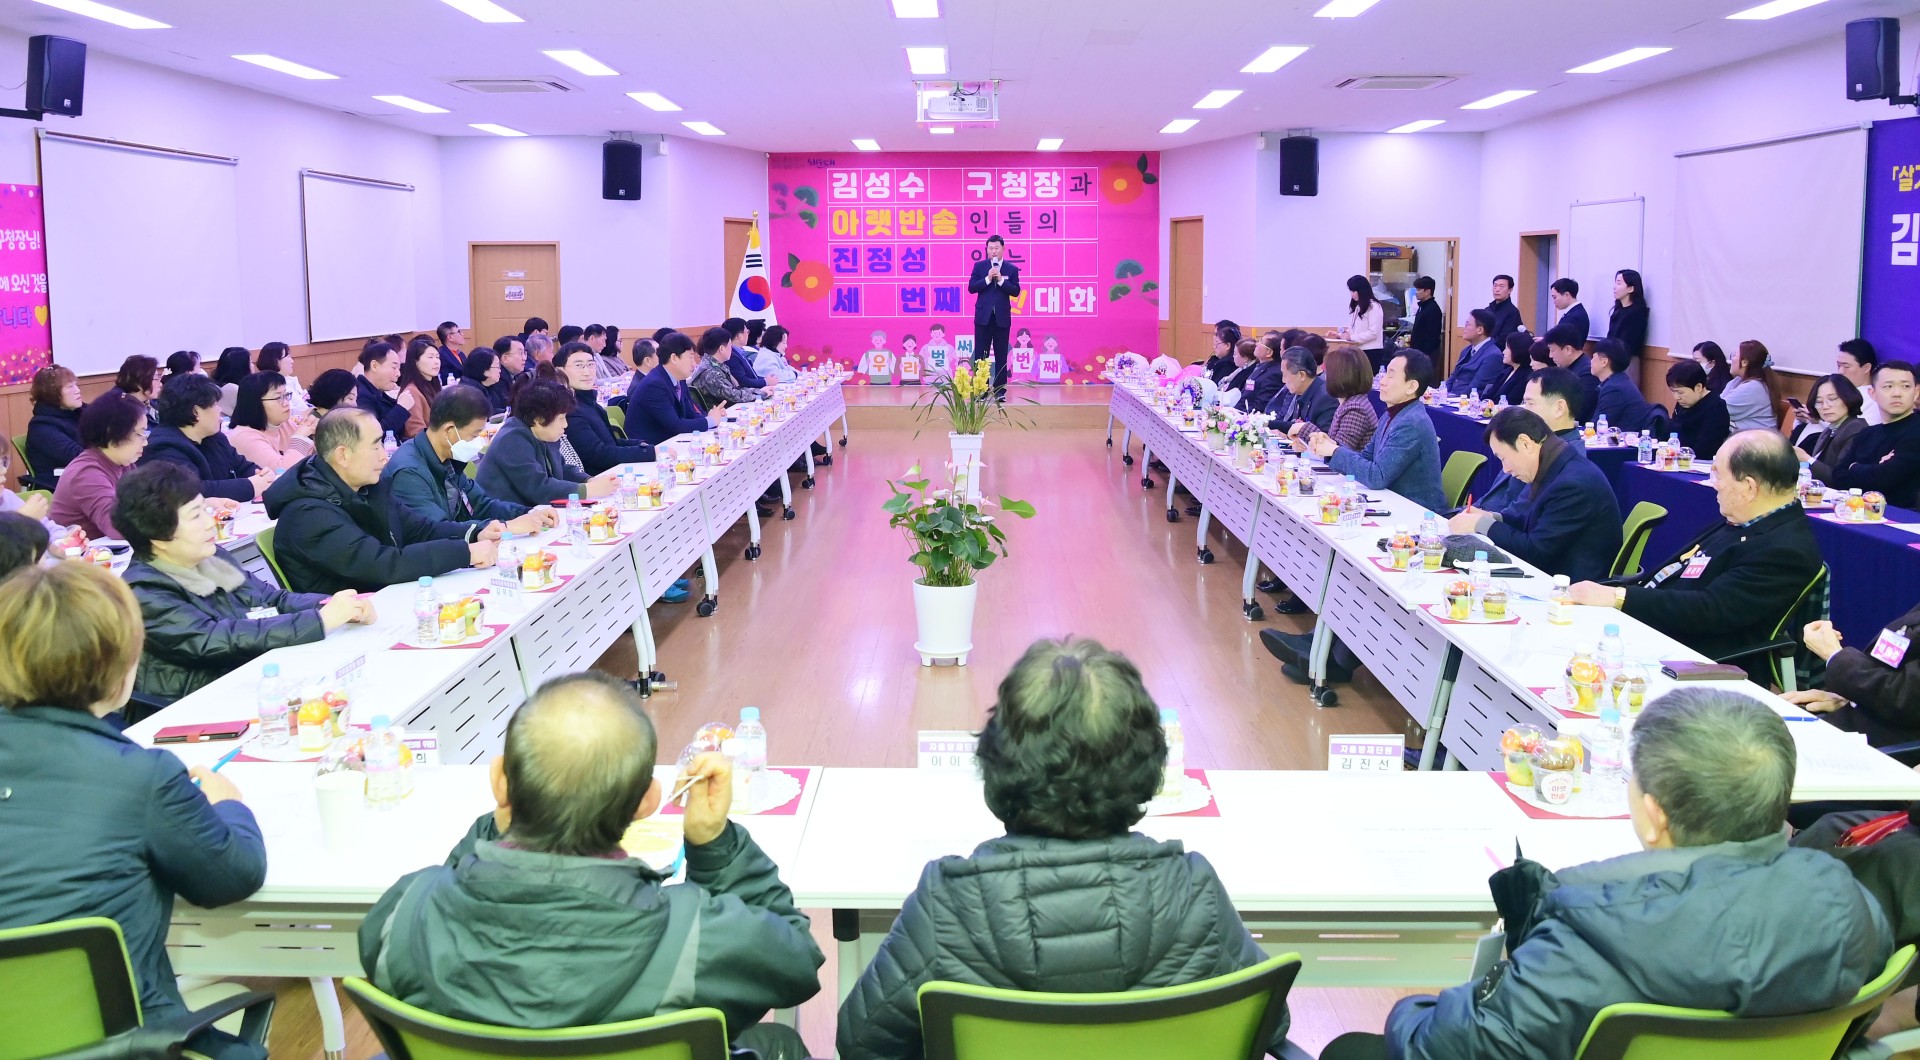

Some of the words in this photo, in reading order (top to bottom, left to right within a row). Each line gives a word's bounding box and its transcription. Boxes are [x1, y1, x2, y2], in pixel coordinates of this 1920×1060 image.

[832, 171, 925, 199] 김성수
[966, 171, 1093, 199] 구청장과
[833, 246, 927, 274] 진정성
[11, 273, 30, 294] 오신
[30, 272, 48, 294] 것을
[832, 286, 860, 314] 세
[900, 286, 961, 313] 번째
